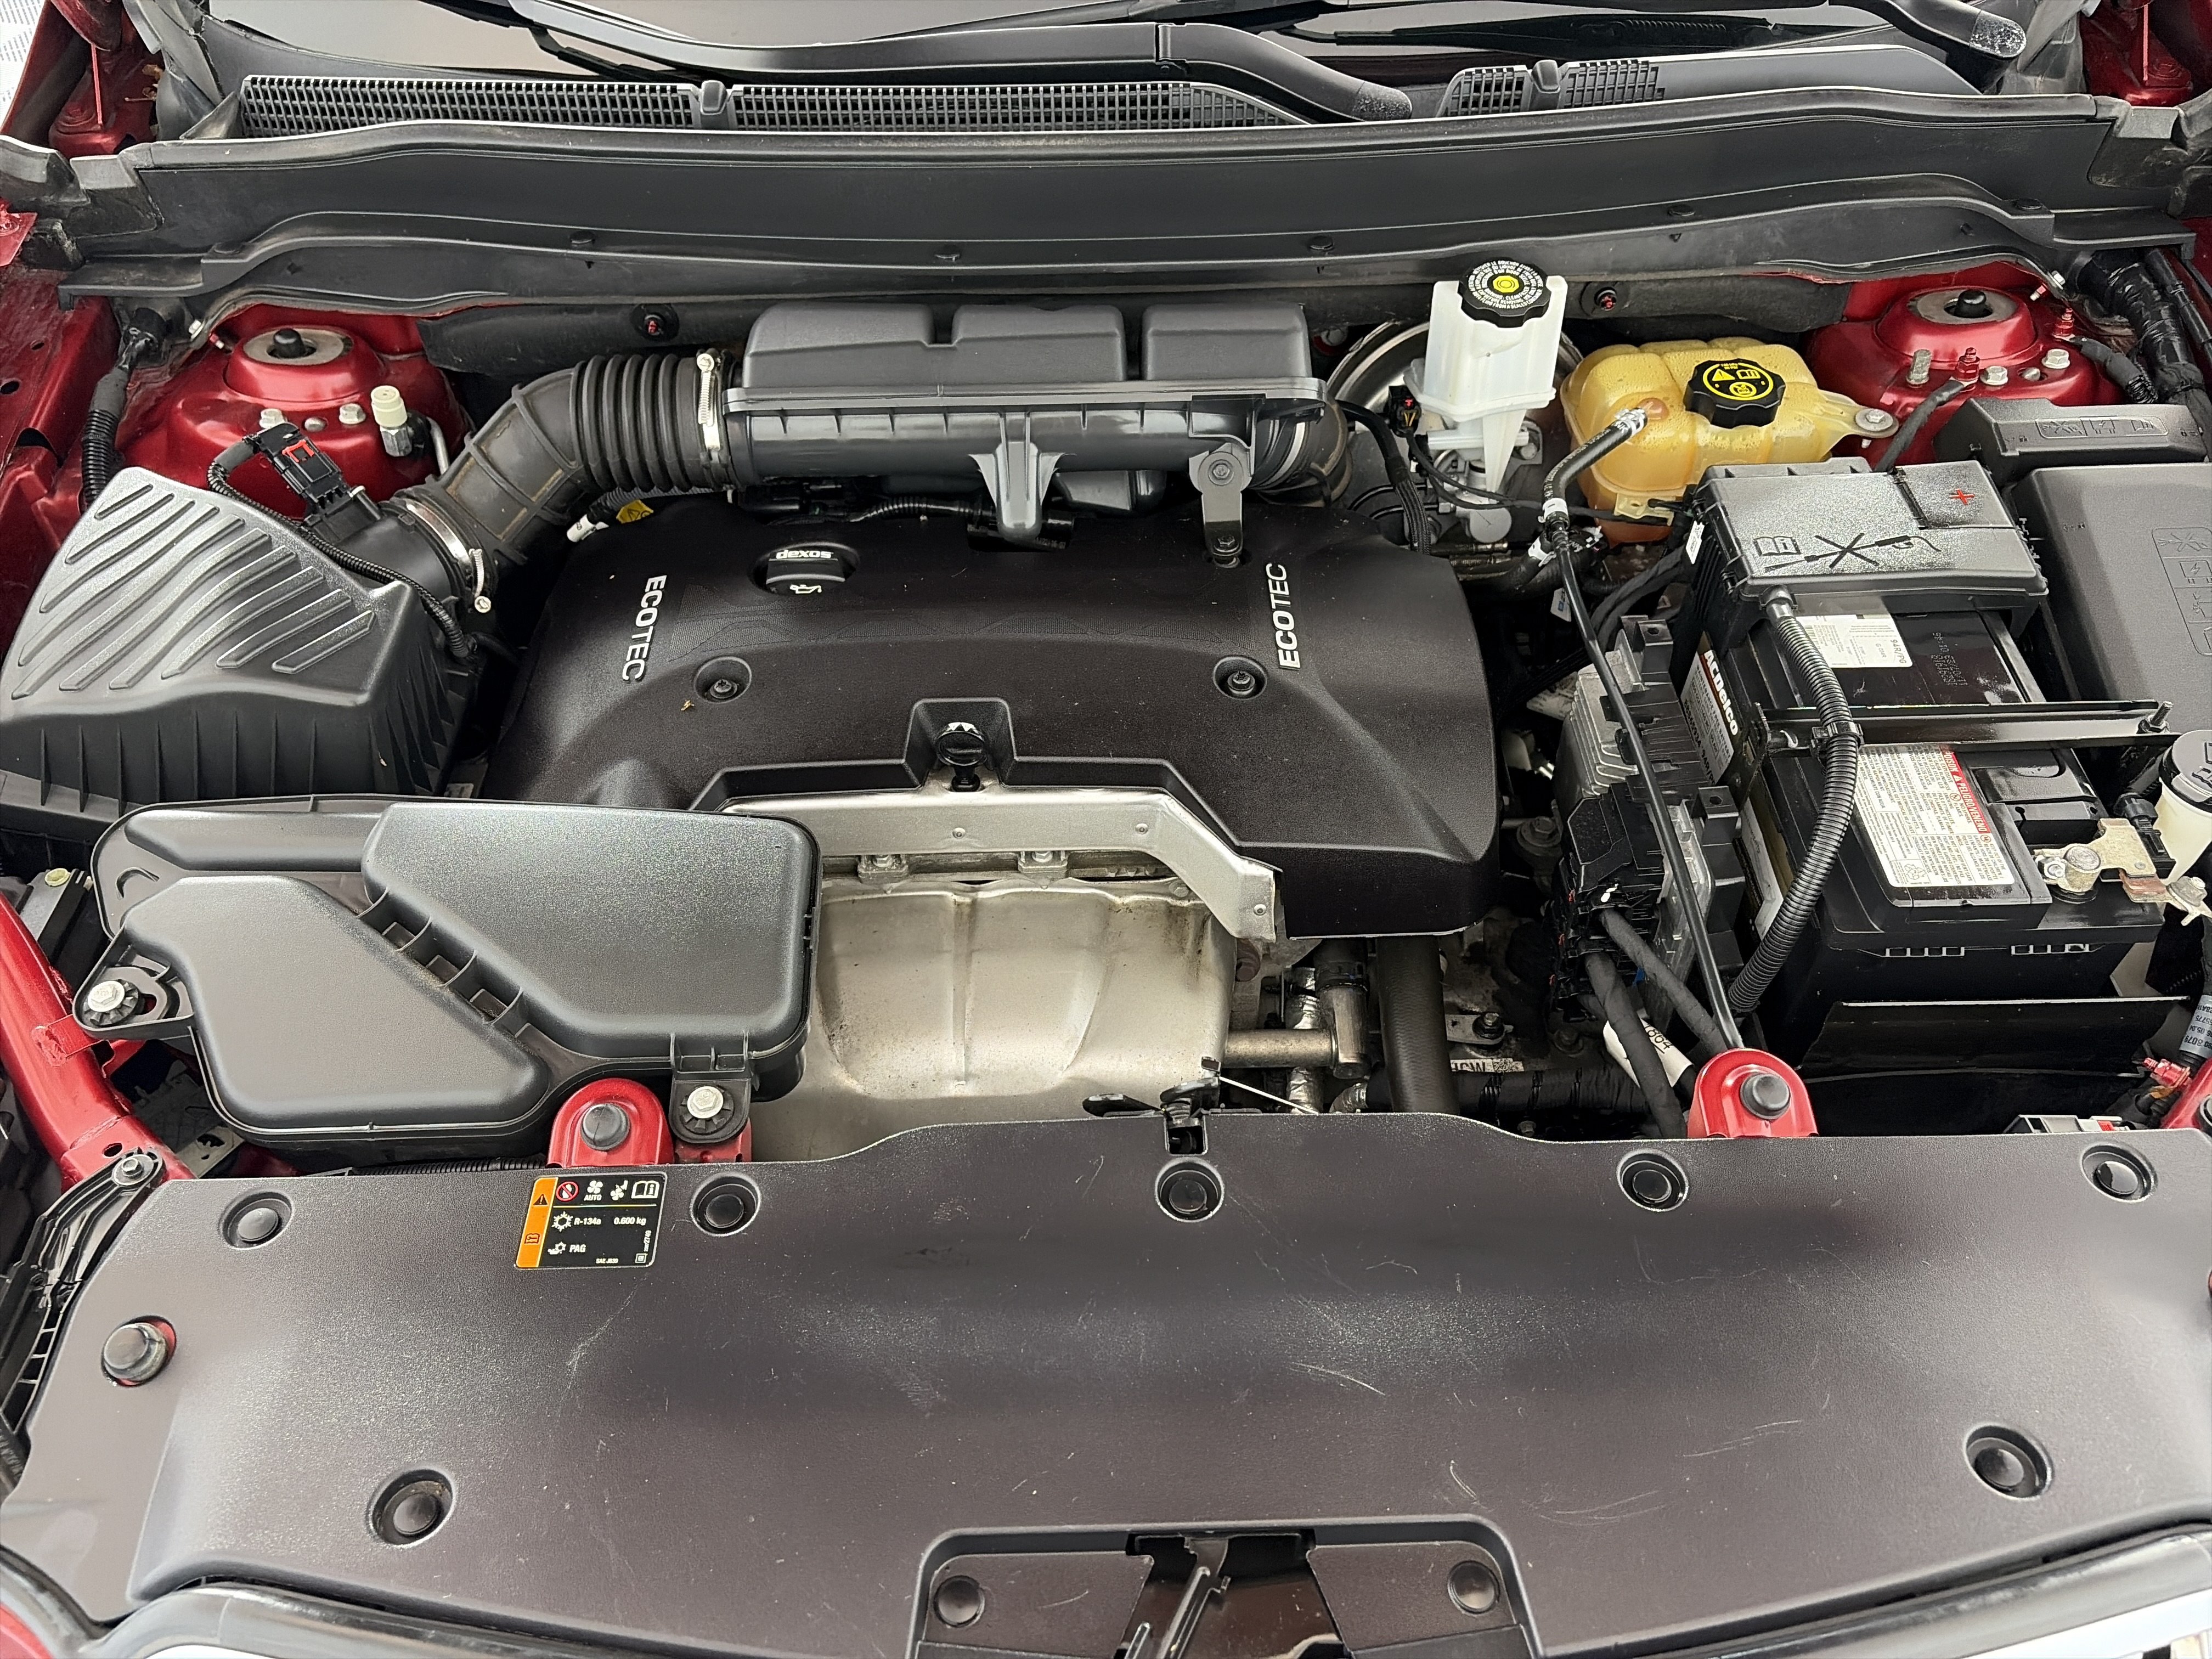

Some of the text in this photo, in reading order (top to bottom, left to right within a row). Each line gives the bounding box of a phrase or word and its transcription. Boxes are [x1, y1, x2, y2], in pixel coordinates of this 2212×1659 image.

[776, 550, 832, 559] dexos
[622, 575, 667, 680] ECOTEC
[1266, 563, 1300, 668] ECOTEC
[1890, 639, 1907, 664] 94R/PG
[1696, 664, 1713, 711] MAINTENANCE
[1718, 727, 1731, 760] BATTERY
[1703, 650, 1738, 736] ACDelco
[1956, 783, 1987, 831] PELIGRO/VENENO
[636, 1217, 646, 1226] kg
[569, 1244, 586, 1252] PAG
